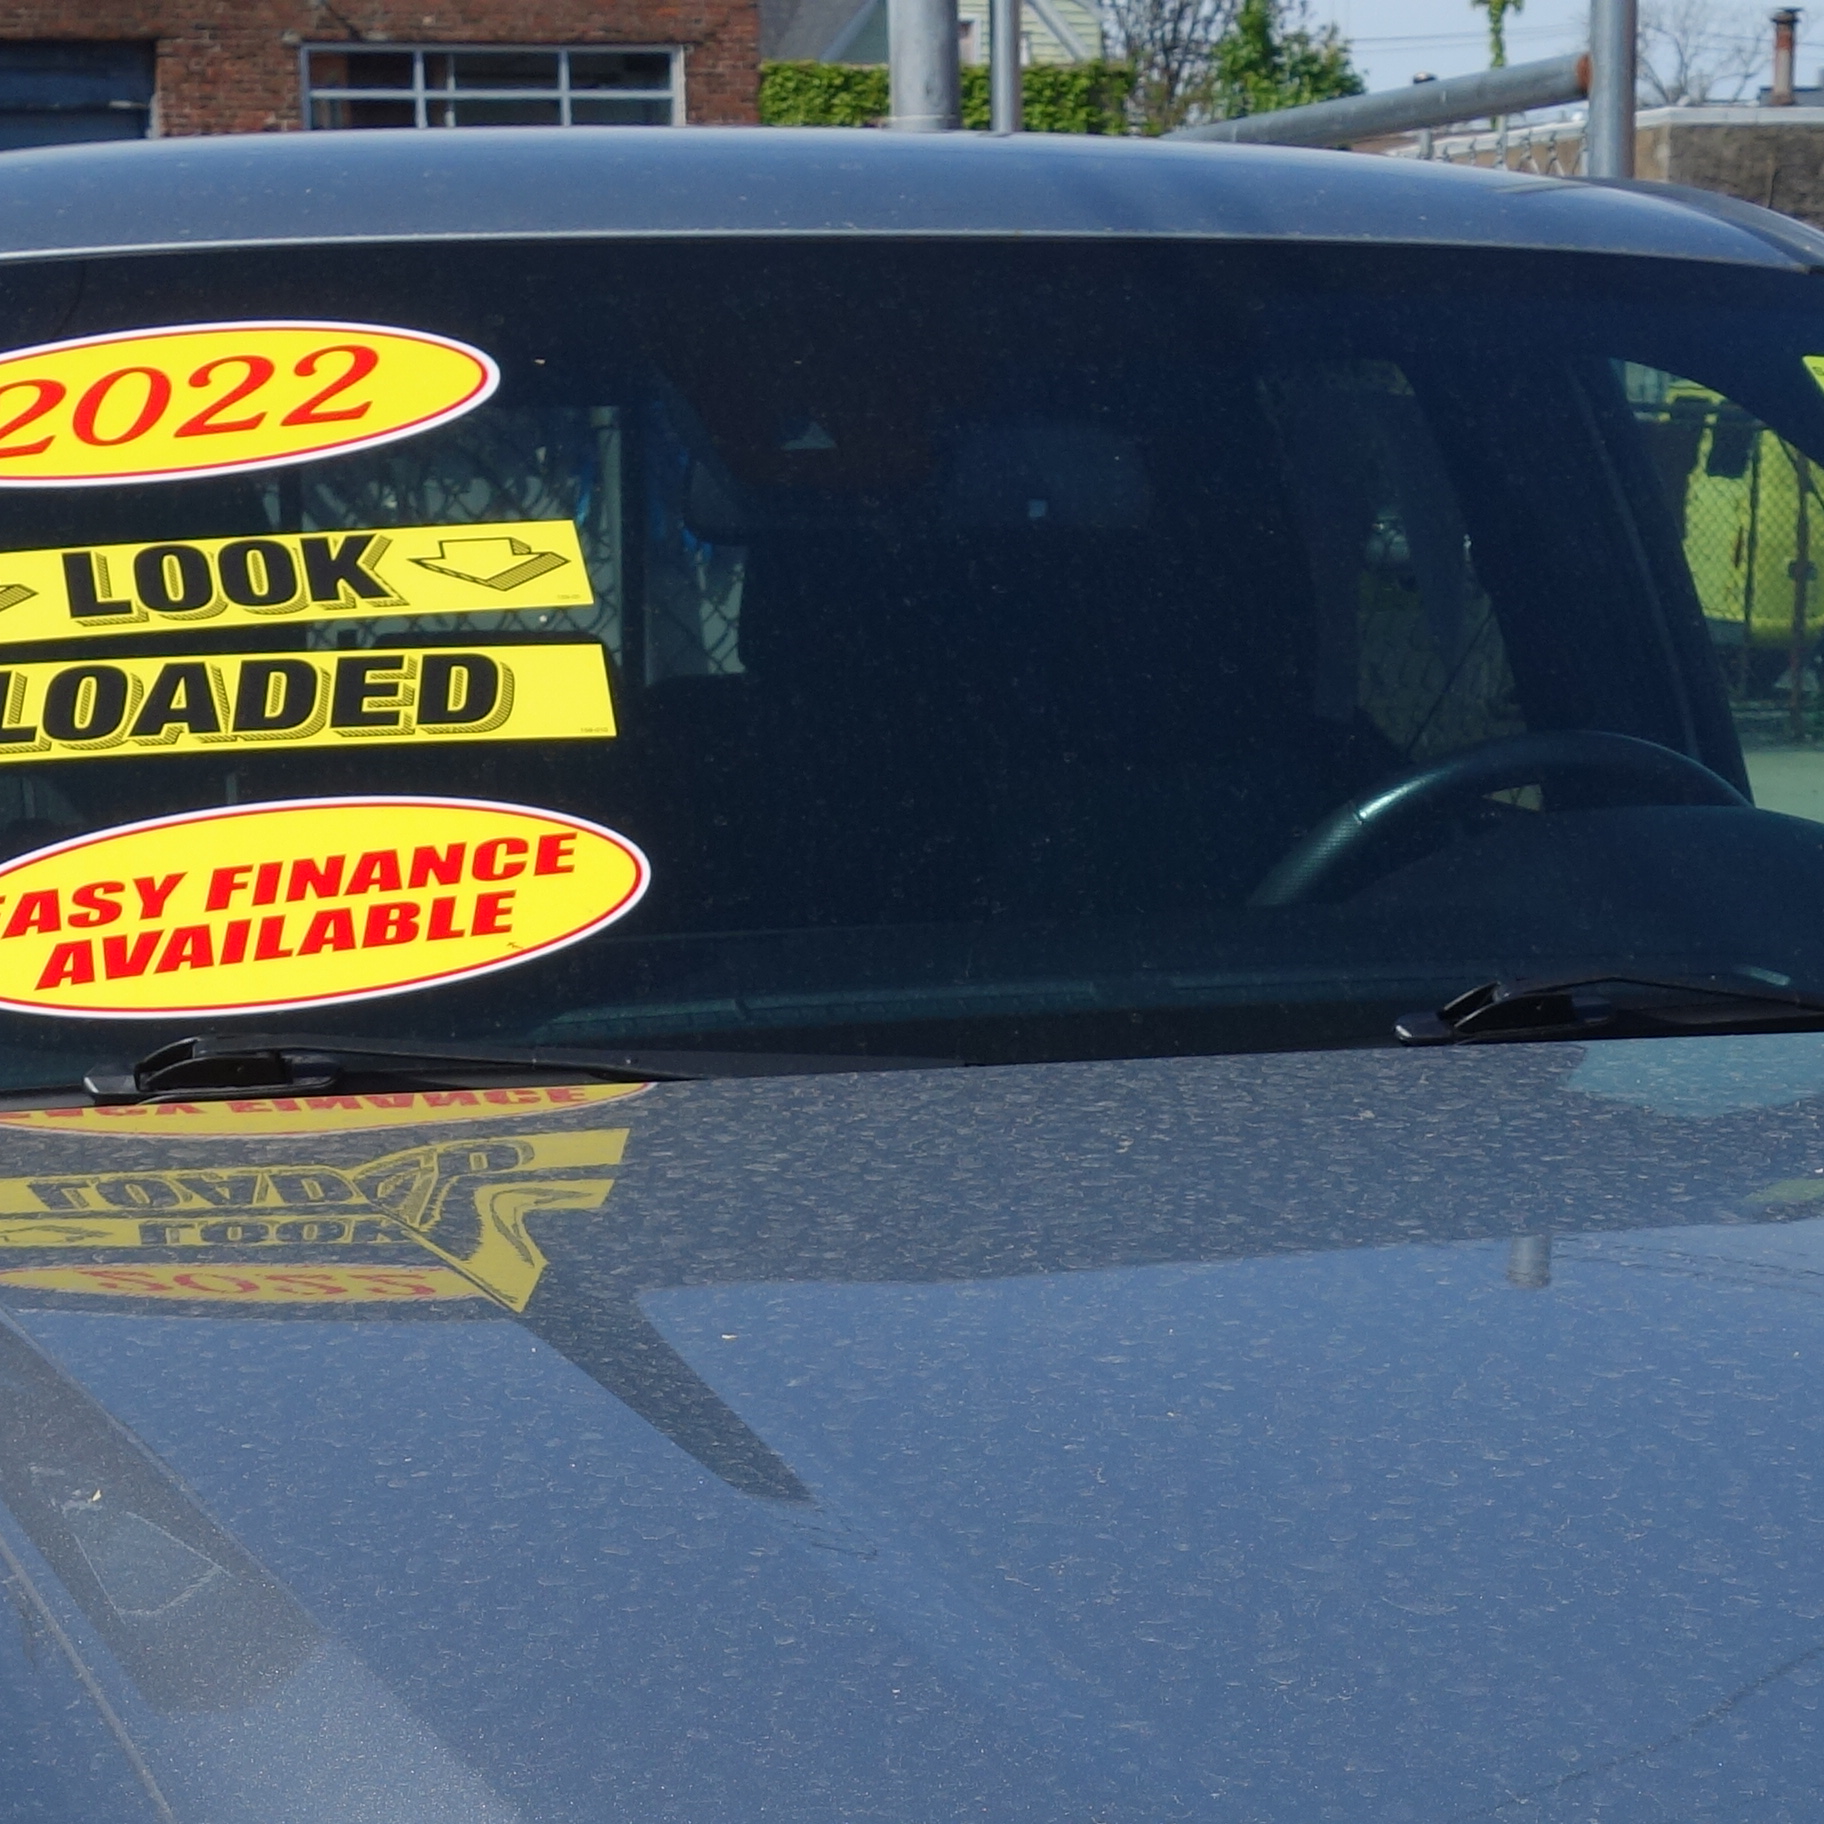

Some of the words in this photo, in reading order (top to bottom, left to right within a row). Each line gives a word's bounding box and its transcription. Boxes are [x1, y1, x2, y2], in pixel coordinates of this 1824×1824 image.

[61, 533, 406, 626] LOOK
[204, 832, 579, 911] FINANCE
[34, 890, 518, 992] AVAILABLE
